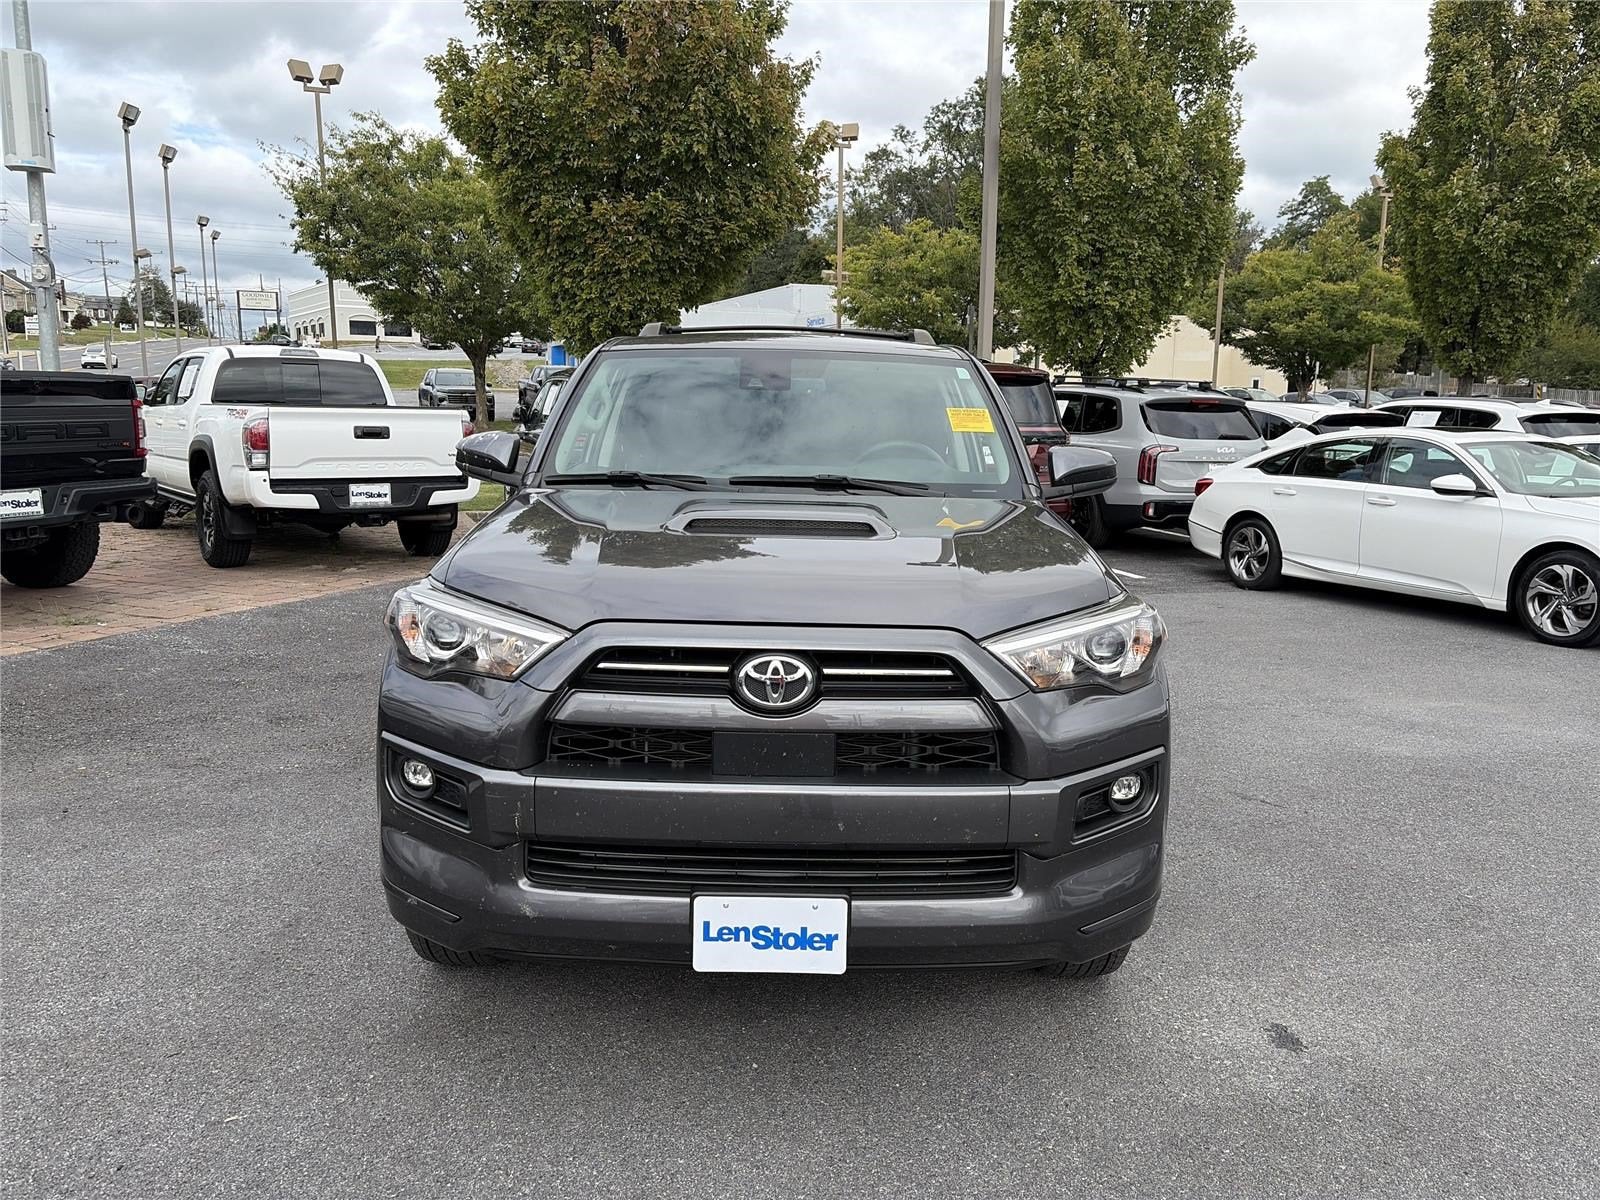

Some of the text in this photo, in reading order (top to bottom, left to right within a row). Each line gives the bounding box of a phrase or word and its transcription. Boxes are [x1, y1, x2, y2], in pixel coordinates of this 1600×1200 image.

[807, 316, 825, 327] Service
[0, 422, 109, 441] RD
[315, 462, 427, 472] TACOMA
[0, 499, 40, 510] enStoler
